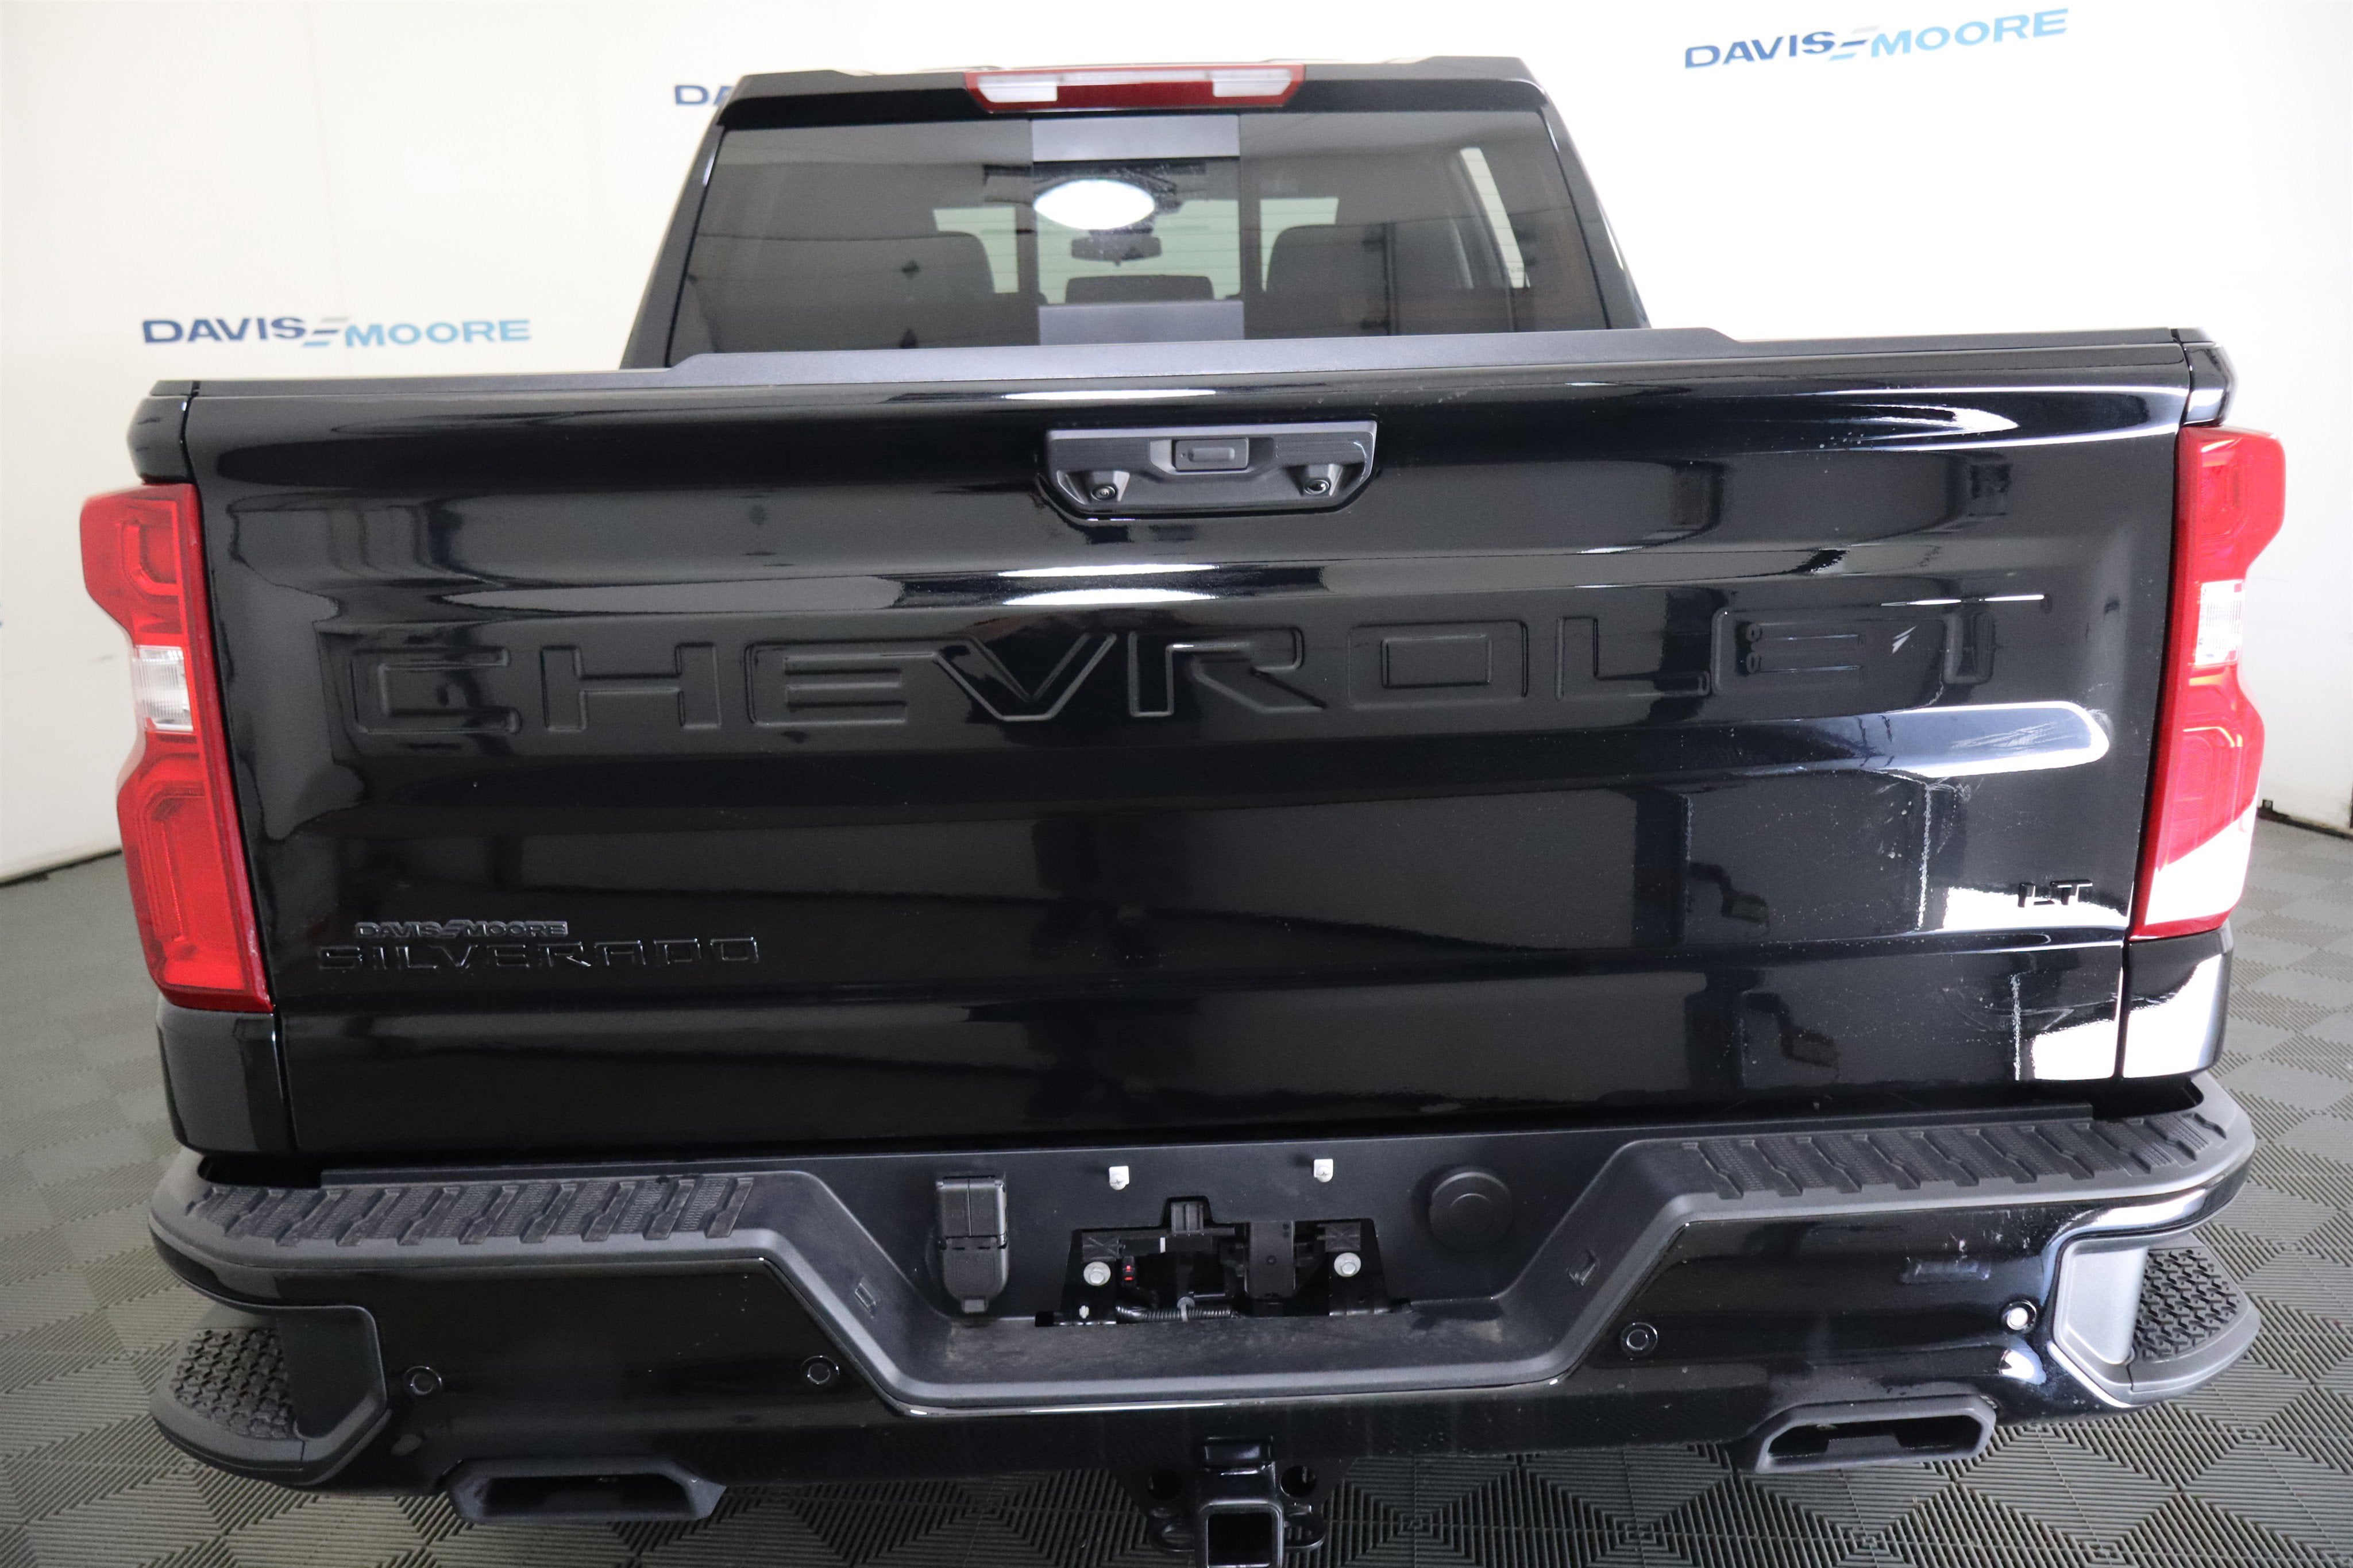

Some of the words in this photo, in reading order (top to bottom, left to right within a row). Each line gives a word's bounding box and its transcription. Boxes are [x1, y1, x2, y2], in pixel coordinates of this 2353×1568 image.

[350, 593, 2050, 737] CHEVROLET
[2017, 879, 2093, 908] LT
[317, 937, 760, 971] SILVERADO
